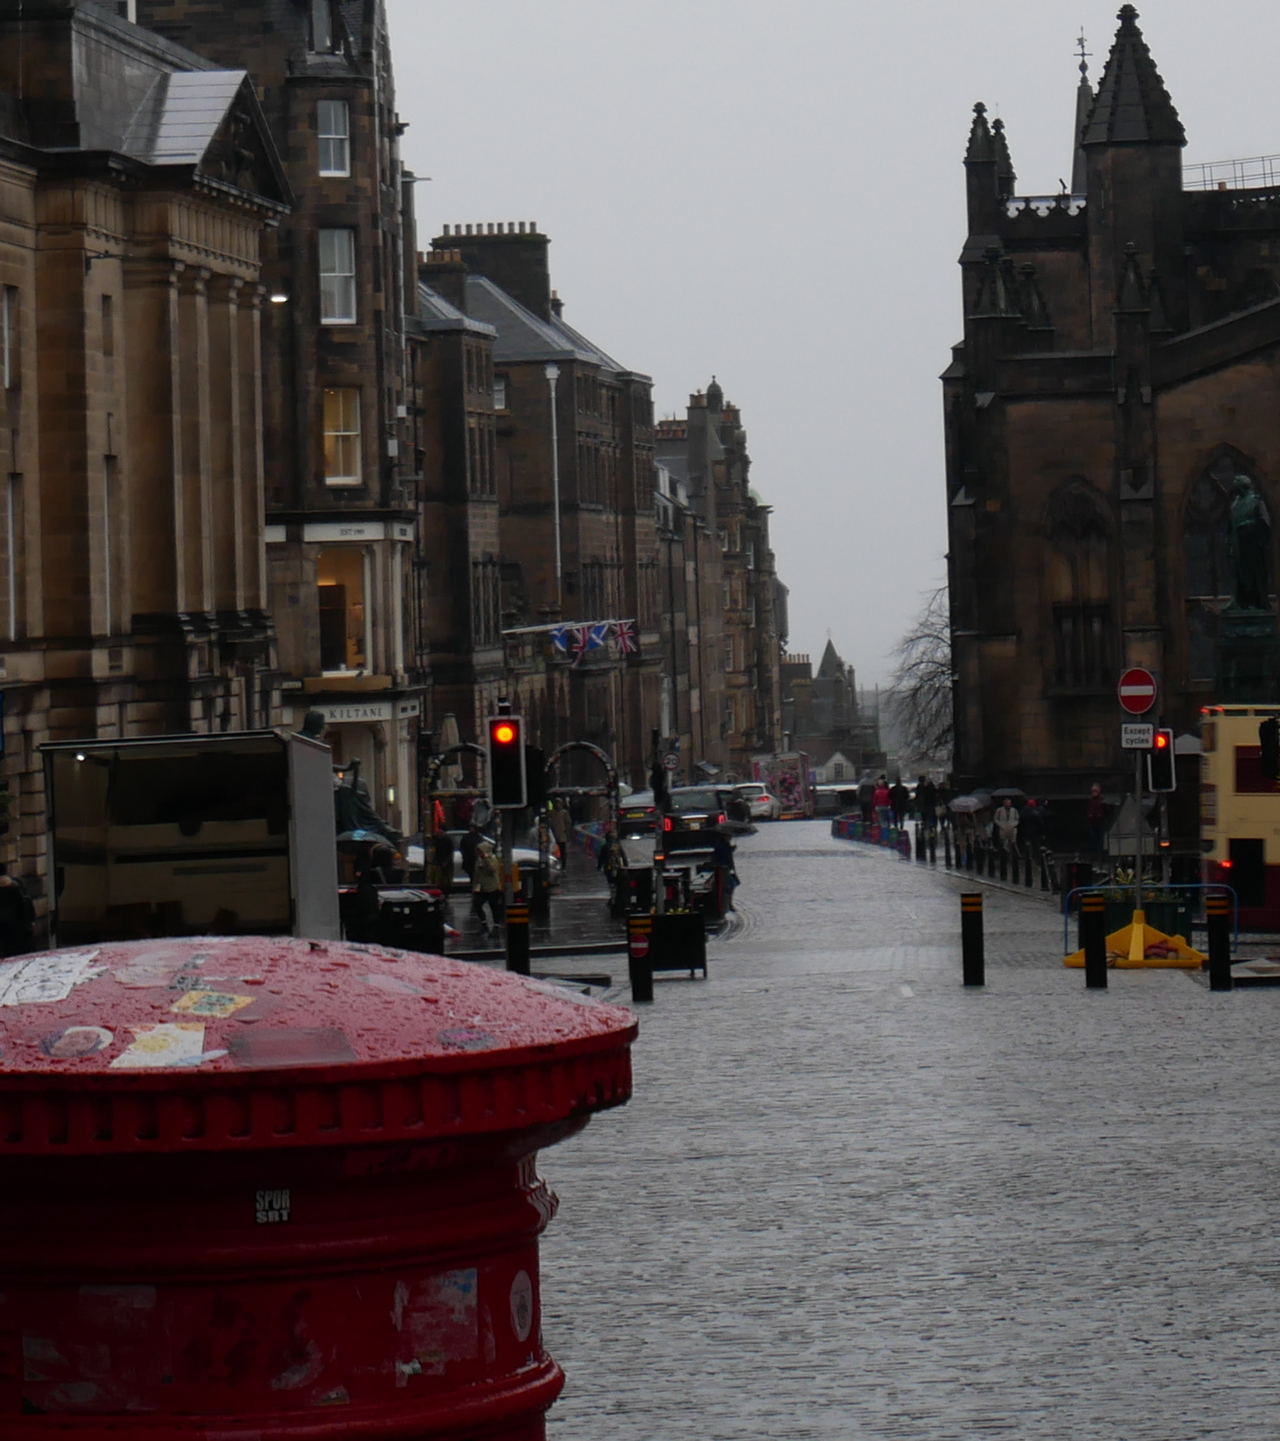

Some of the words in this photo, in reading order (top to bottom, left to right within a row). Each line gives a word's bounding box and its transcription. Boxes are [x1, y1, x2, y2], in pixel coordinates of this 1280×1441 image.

[329, 707, 383, 720] KILTANE
[1124, 726, 1150, 736] Except
[1125, 736, 1149, 746] cycles
